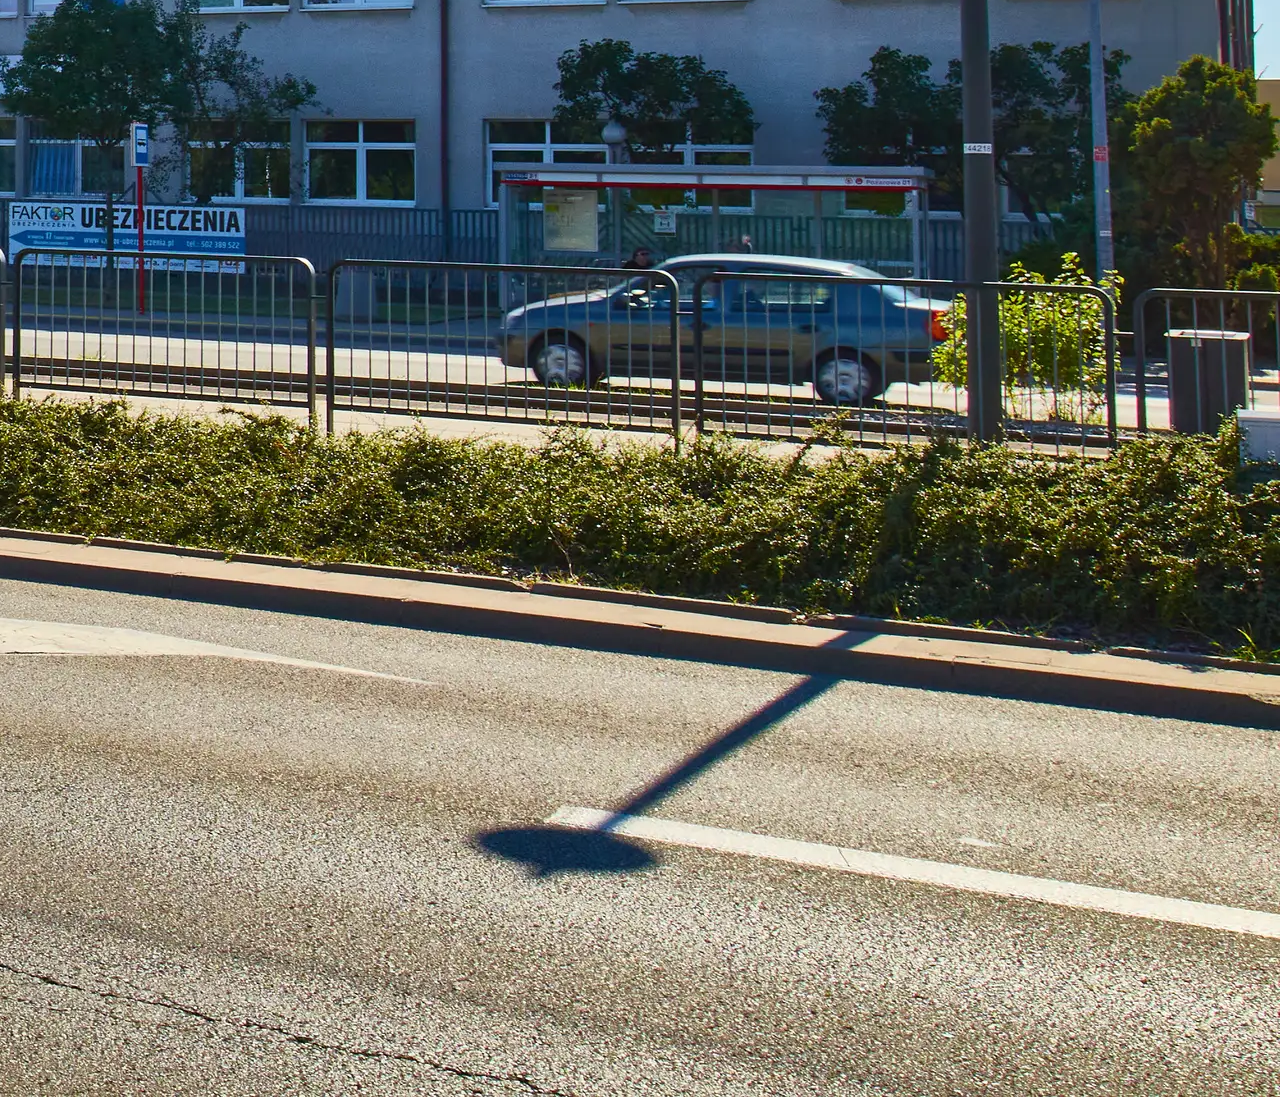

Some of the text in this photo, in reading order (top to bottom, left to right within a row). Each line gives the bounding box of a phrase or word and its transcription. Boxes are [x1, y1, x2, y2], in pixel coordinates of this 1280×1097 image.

[12, 205, 75, 221] FAKTOR
[81, 207, 241, 233] UBEZPIECZENIA
[201, 241, 213, 249] 502
[214, 241, 227, 249] 389
